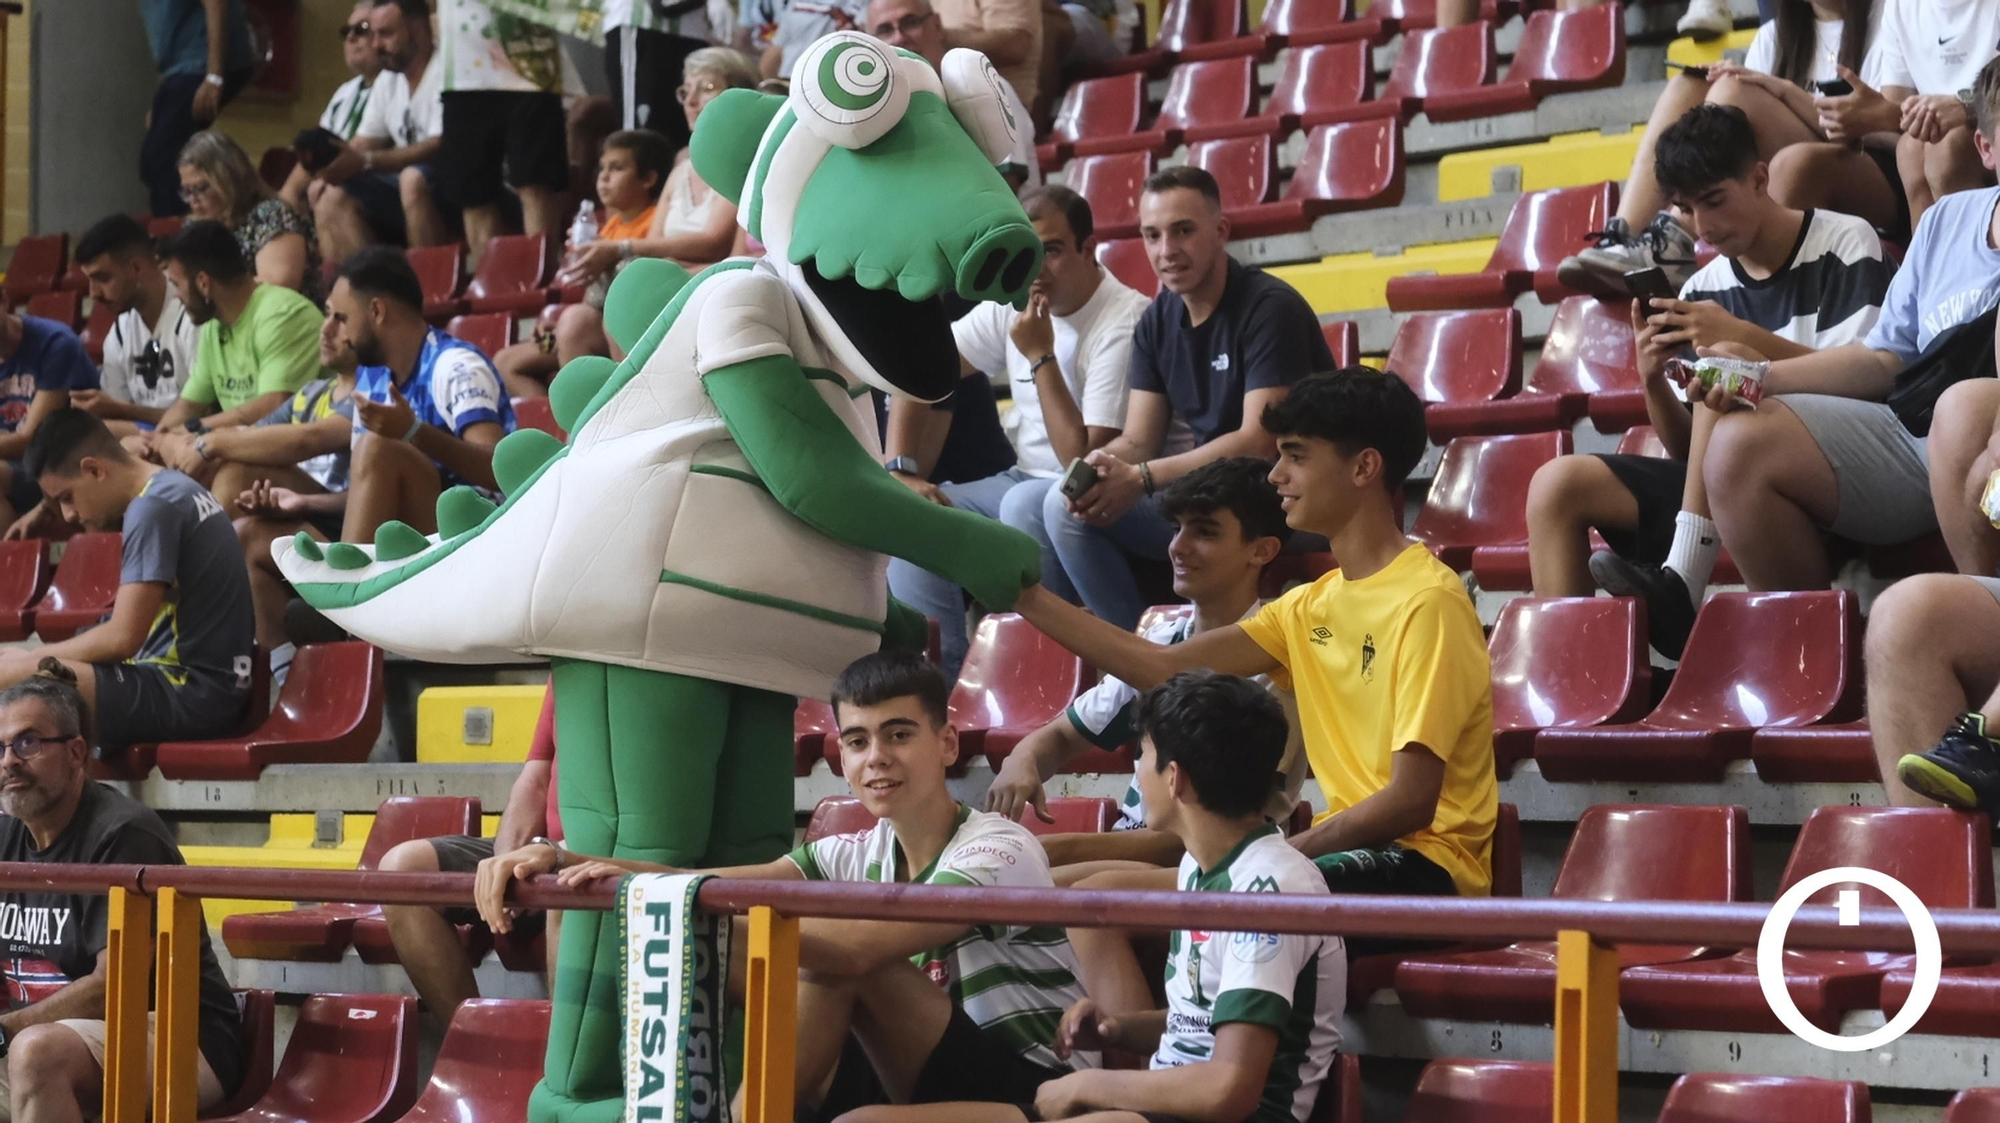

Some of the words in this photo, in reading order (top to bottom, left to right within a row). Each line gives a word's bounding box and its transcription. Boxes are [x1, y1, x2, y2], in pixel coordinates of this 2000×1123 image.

[1923, 291, 1966, 337] NEW
[376, 779, 418, 796] FILA
[632, 887, 644, 918] DE
[631, 934, 641, 965] LA
[636, 901, 672, 1123] FUTSAL
[1491, 1029, 1503, 1052] 8
[1728, 1041, 1742, 1063] 9
